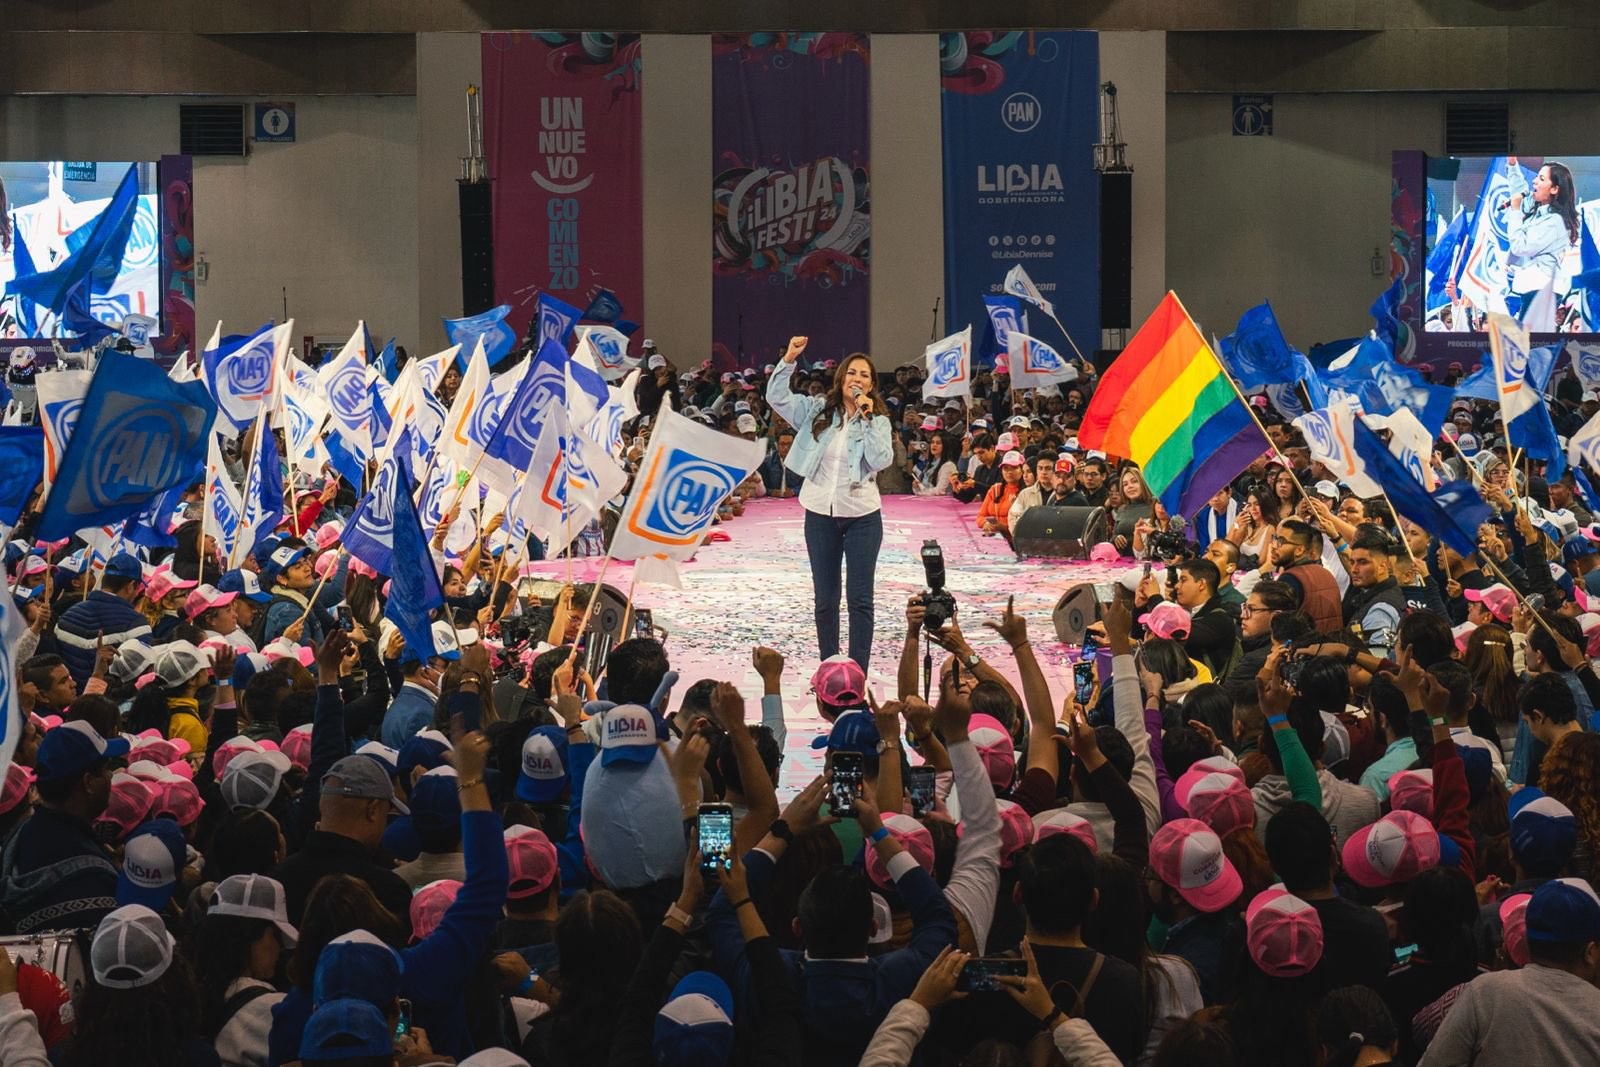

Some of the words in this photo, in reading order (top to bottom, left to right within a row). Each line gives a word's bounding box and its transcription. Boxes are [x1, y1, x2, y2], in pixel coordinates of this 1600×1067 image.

[540, 97, 583, 129] UN
[1008, 102, 1034, 122] PAN
[539, 131, 586, 154] NUE
[546, 156, 578, 179] VO
[977, 164, 1064, 194] LIBIA
[547, 198, 579, 221] CO
[978, 196, 1064, 204] GOBERNADORA
[548, 222, 579, 243] MI
[757, 209, 816, 250] FEST!
[548, 244, 580, 266] EN
[992, 250, 1054, 259] @LibiaDennise
[548, 267, 579, 290] ZO
[521, 385, 560, 425] PA
[101, 430, 171, 487] PAN
[608, 718, 647, 734] LIBIA
[127, 857, 162, 880] LIBIA
